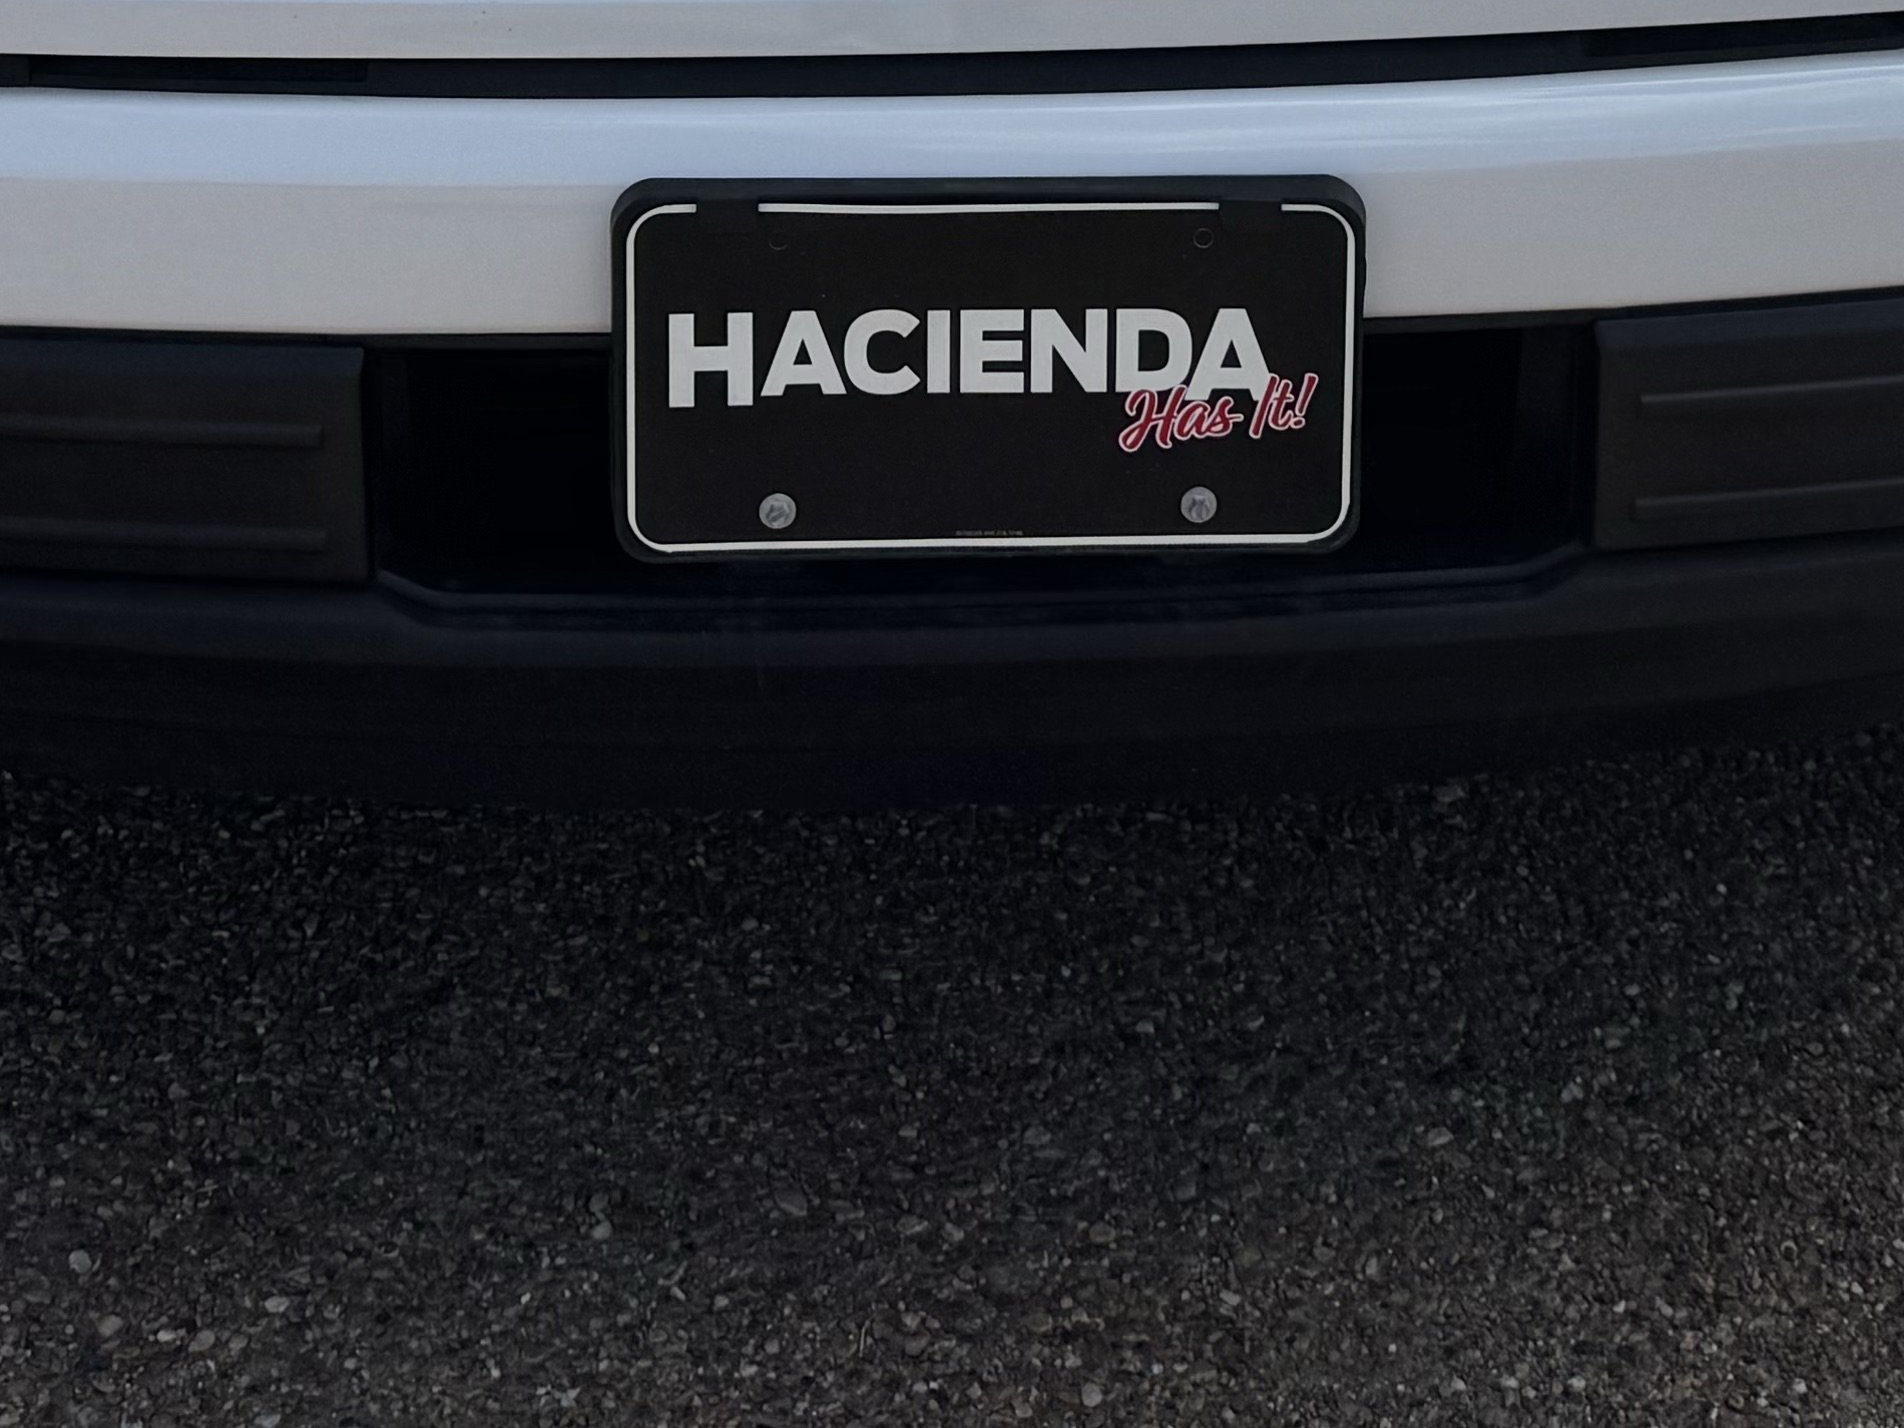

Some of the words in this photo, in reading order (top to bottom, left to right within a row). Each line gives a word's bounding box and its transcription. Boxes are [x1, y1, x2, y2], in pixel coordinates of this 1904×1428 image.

[667, 307, 1271, 408] HACIENDA
[1118, 383, 1243, 452] Has
[1248, 373, 1319, 440] It!
